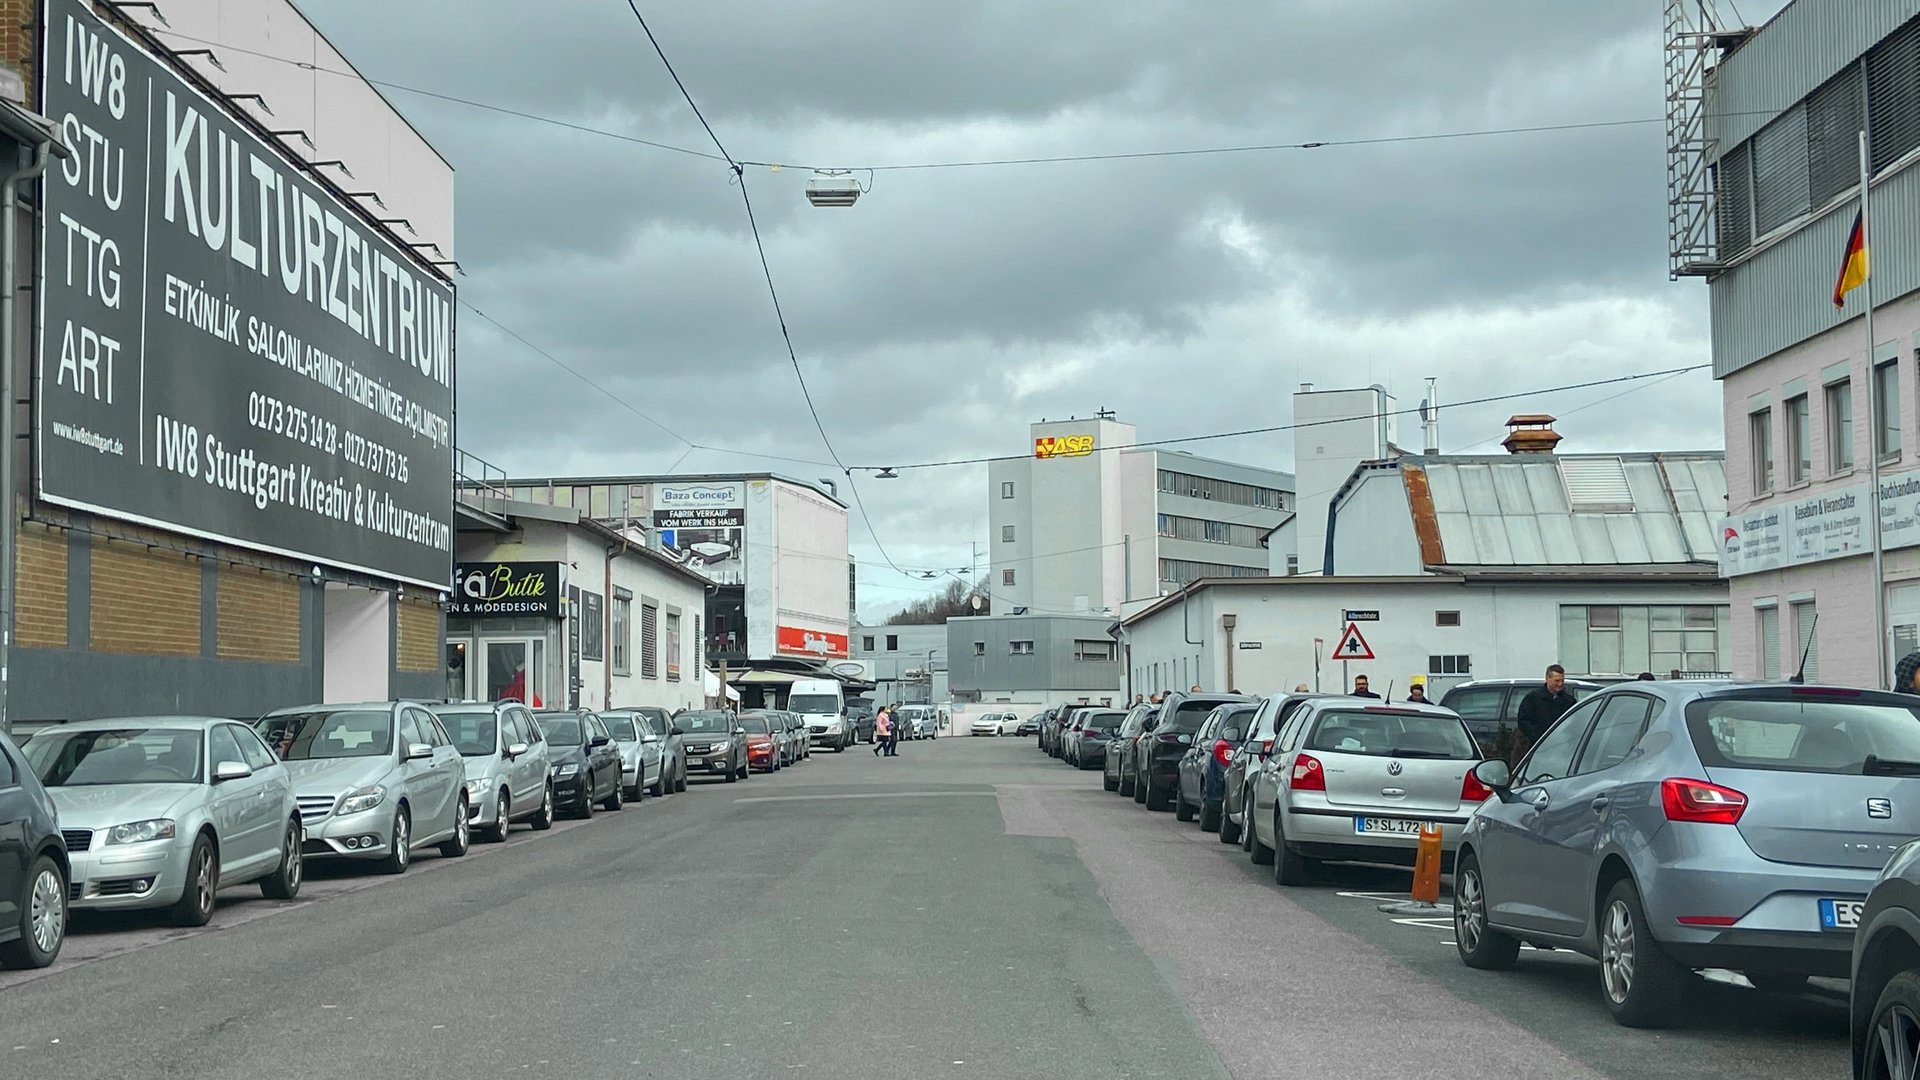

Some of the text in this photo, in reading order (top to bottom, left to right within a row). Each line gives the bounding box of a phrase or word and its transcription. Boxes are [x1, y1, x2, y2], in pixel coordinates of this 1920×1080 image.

[65, 15, 126, 121] IW8
[62, 112, 124, 211] STU
[60, 212, 122, 310] TTG
[164, 90, 449, 388] KULTURZENTRUM
[57, 319, 121, 405] ART
[164, 273, 241, 346] ETKİNLİK
[248, 316, 343, 394] SALONLARIMIZ
[344, 361, 403, 425] HİZMETİNİZE
[52, 421, 124, 456] www.iw8stuttgart.de
[249, 391, 283, 434] 0173
[286, 404, 308, 443] 275
[310, 415, 323, 449] 14
[324, 421, 337, 455] 28
[344, 430, 365, 467] 0172
[366, 441, 384, 474] 737
[385, 450, 396, 479] 73
[397, 453, 409, 484] 26
[1051, 434, 1095, 458] ASB
[156, 414, 449, 552] IW8 Stuttgart Kreativ & Kulturzentrum
[665, 490, 732, 500] Baza Concept
[669, 509, 729, 518] FABRIK VERKAUF
[660, 518, 738, 527] VOM WERK INS HAUS
[463, 603, 471, 613] &
[474, 602, 547, 613] MODEDESIGN
[486, 564, 546, 600] Butik
[1365, 818, 1373, 830] S
[1380, 820, 1396, 831] SL
